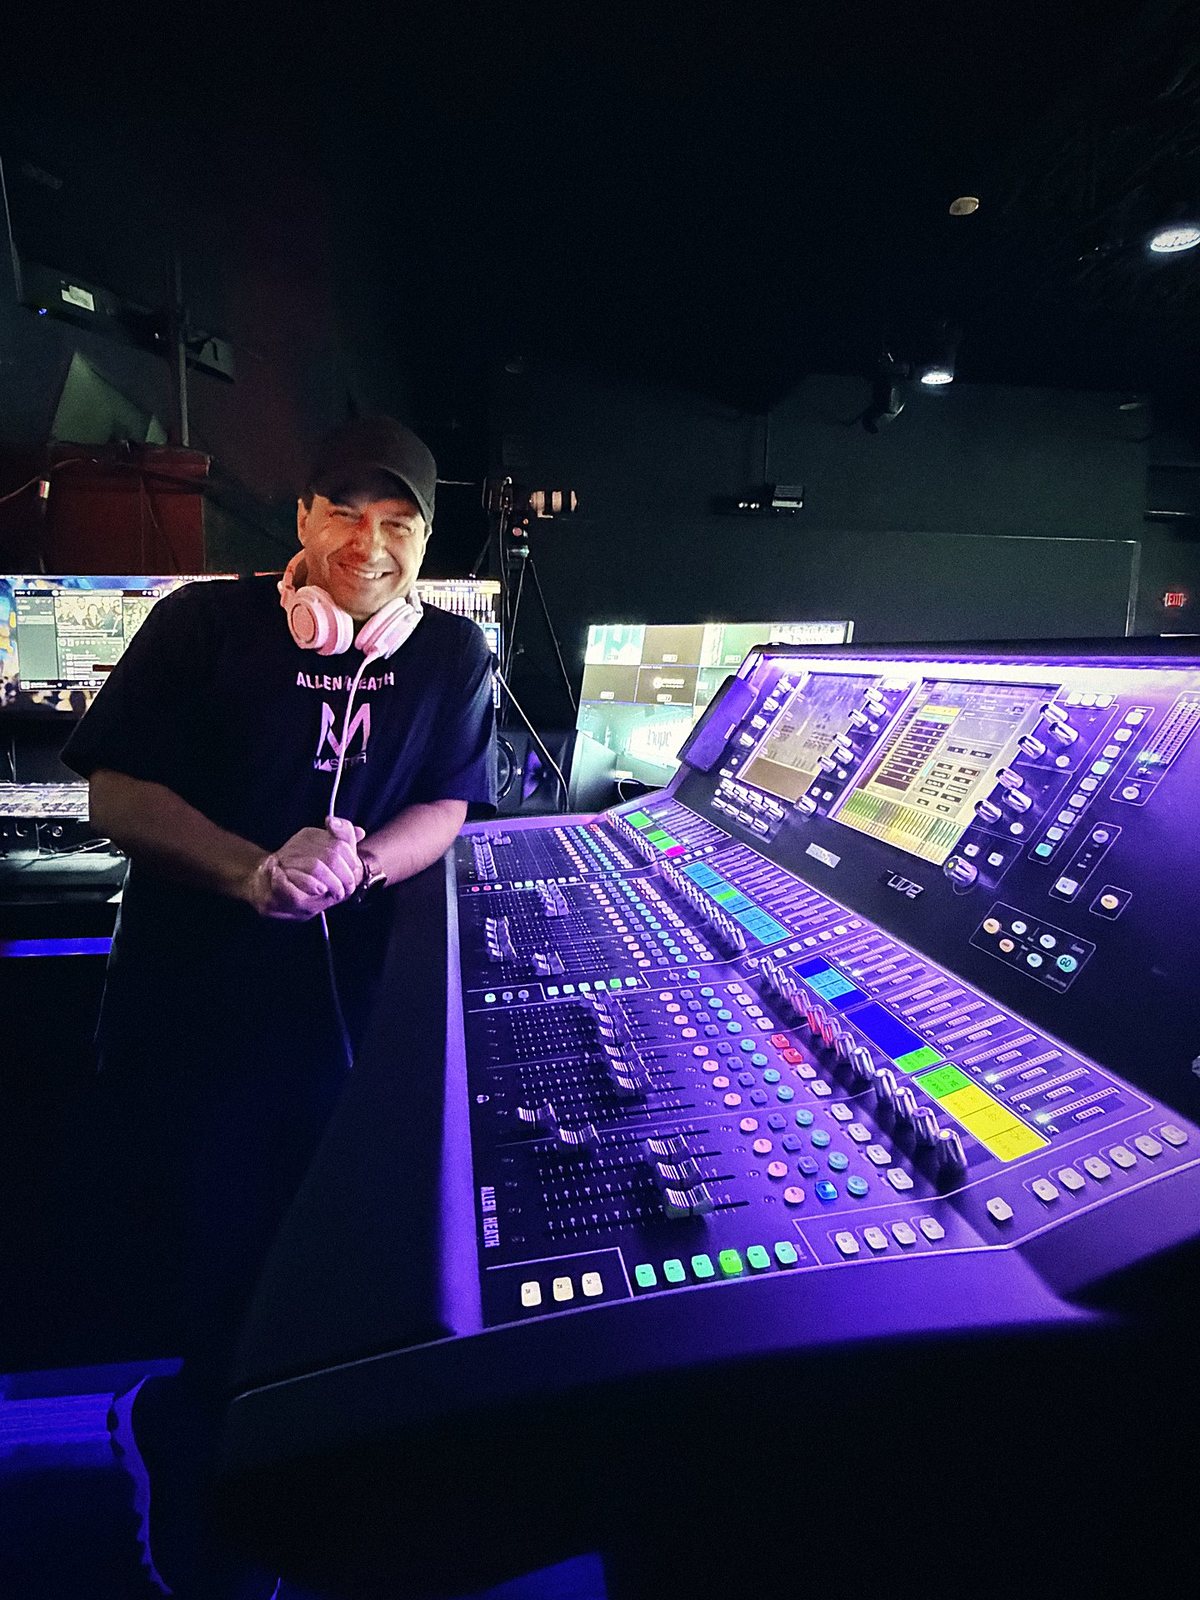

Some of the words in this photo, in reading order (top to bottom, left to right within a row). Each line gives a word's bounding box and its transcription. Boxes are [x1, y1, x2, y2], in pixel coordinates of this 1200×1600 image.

[297, 671, 342, 691] ALLEN
[1059, 957, 1072, 967] GO
[483, 1216, 500, 1248] HEATH
